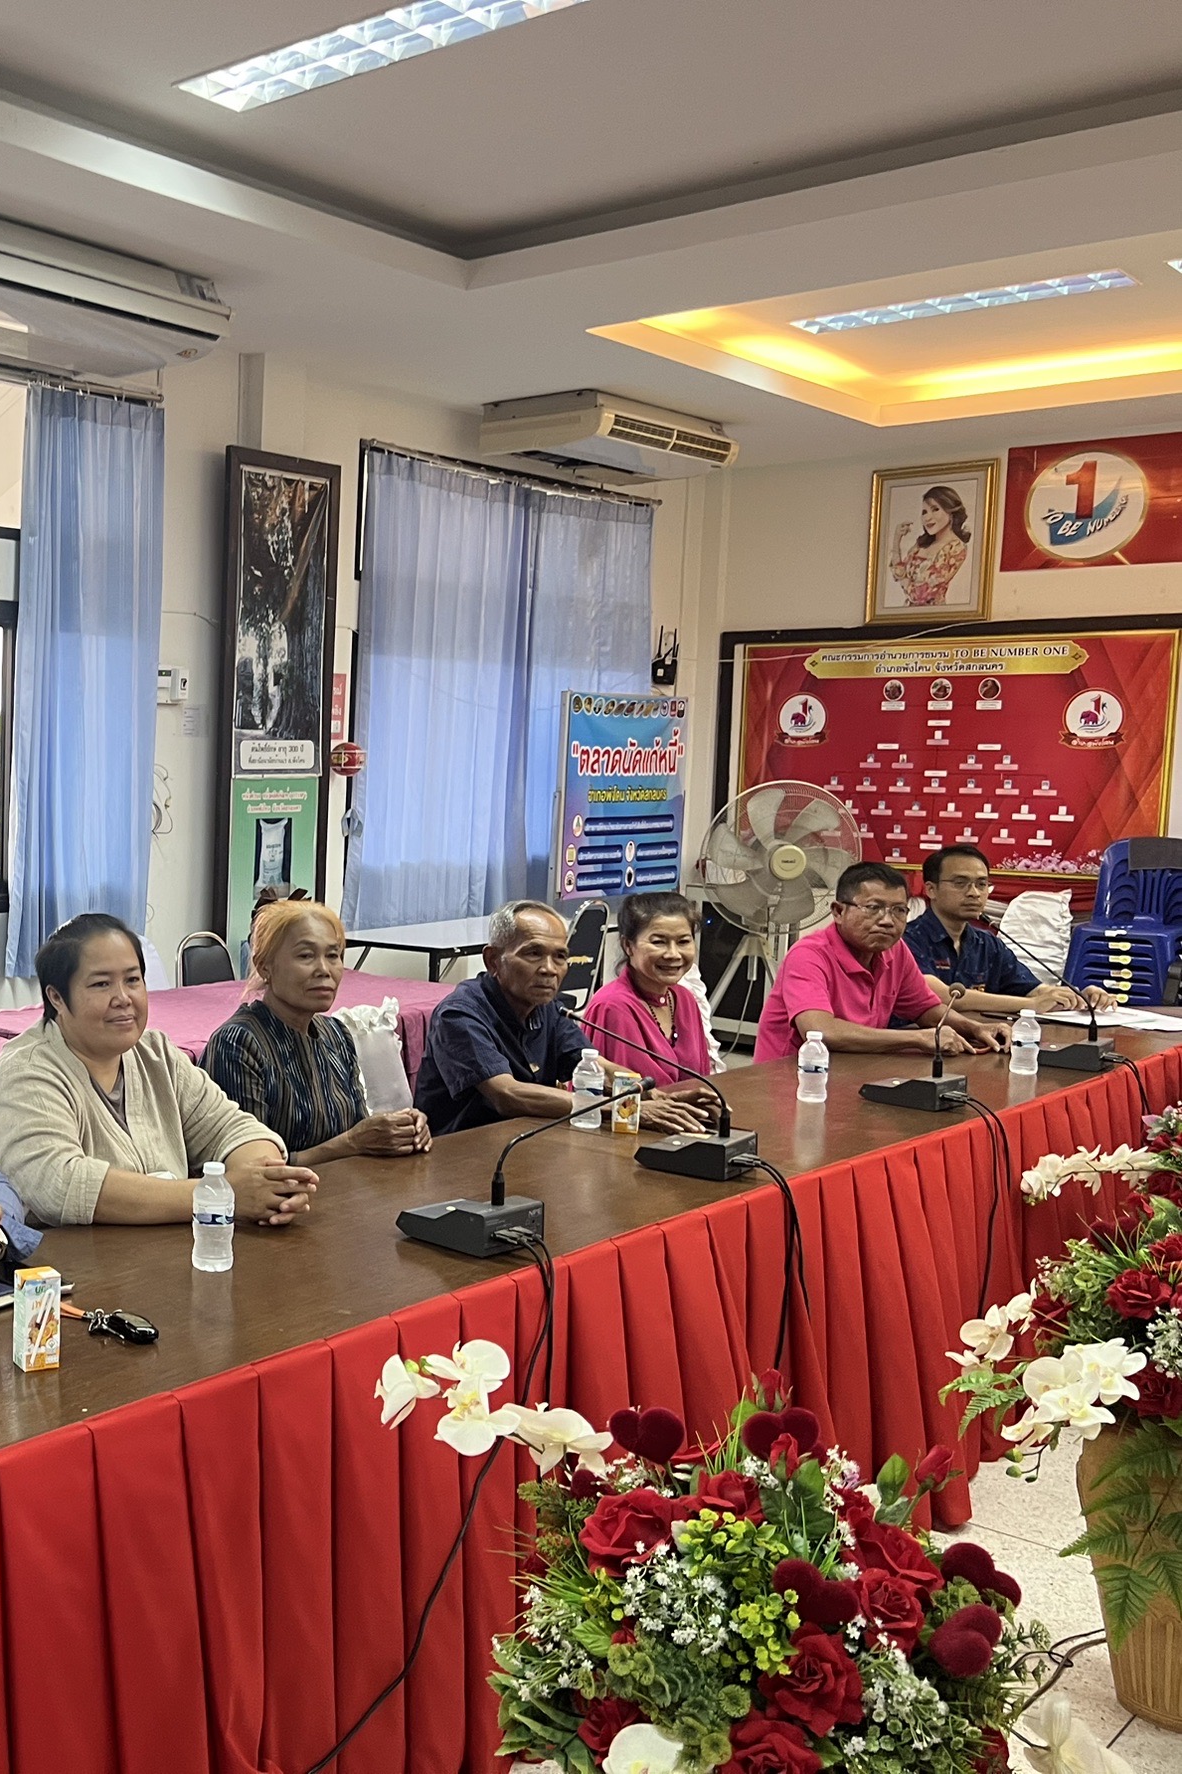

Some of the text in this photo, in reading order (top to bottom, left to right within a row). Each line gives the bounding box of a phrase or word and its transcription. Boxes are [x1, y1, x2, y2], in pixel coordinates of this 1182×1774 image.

[1066, 461, 1097, 519] 1
[1057, 520, 1083, 537] BE
[954, 649, 969, 658] TO
[973, 648, 986, 657] BE
[990, 647, 1038, 657] NUMBER
[1043, 646, 1068, 656] ONE
[875, 662, 1004, 674] อำเภอพังโคน จังหวัดสกลนคร
